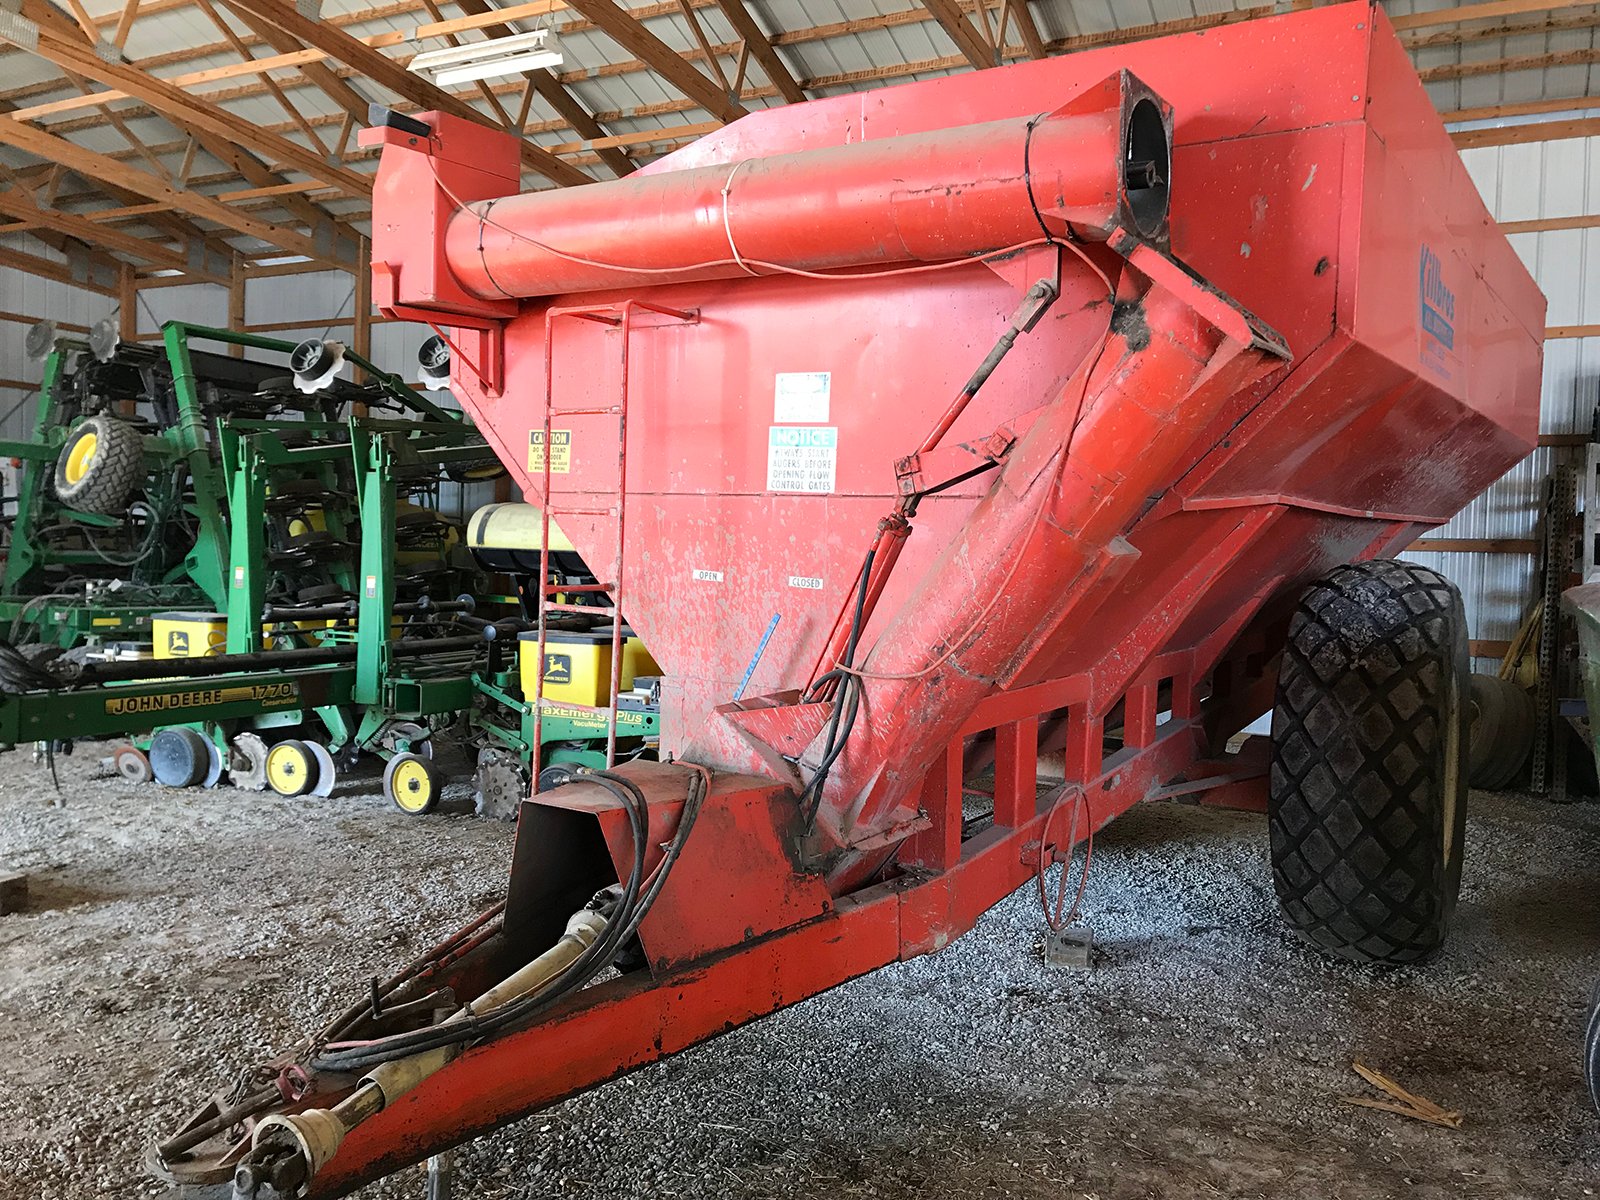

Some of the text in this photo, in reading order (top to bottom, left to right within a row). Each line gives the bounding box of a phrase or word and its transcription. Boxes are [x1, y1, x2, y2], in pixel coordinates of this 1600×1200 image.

[533, 432, 567, 444] CAION
[776, 429, 831, 446] NOTICE
[773, 459, 832, 470] AUGERS BEFORE
[772, 470, 830, 480] OPENING FLOW
[770, 480, 832, 491] CONTROL GATES
[699, 570, 718, 581] OPEN
[792, 577, 820, 588] CLOSED
[113, 683, 292, 714] JOHN DEERE 1770
[616, 710, 642, 724] Plus
